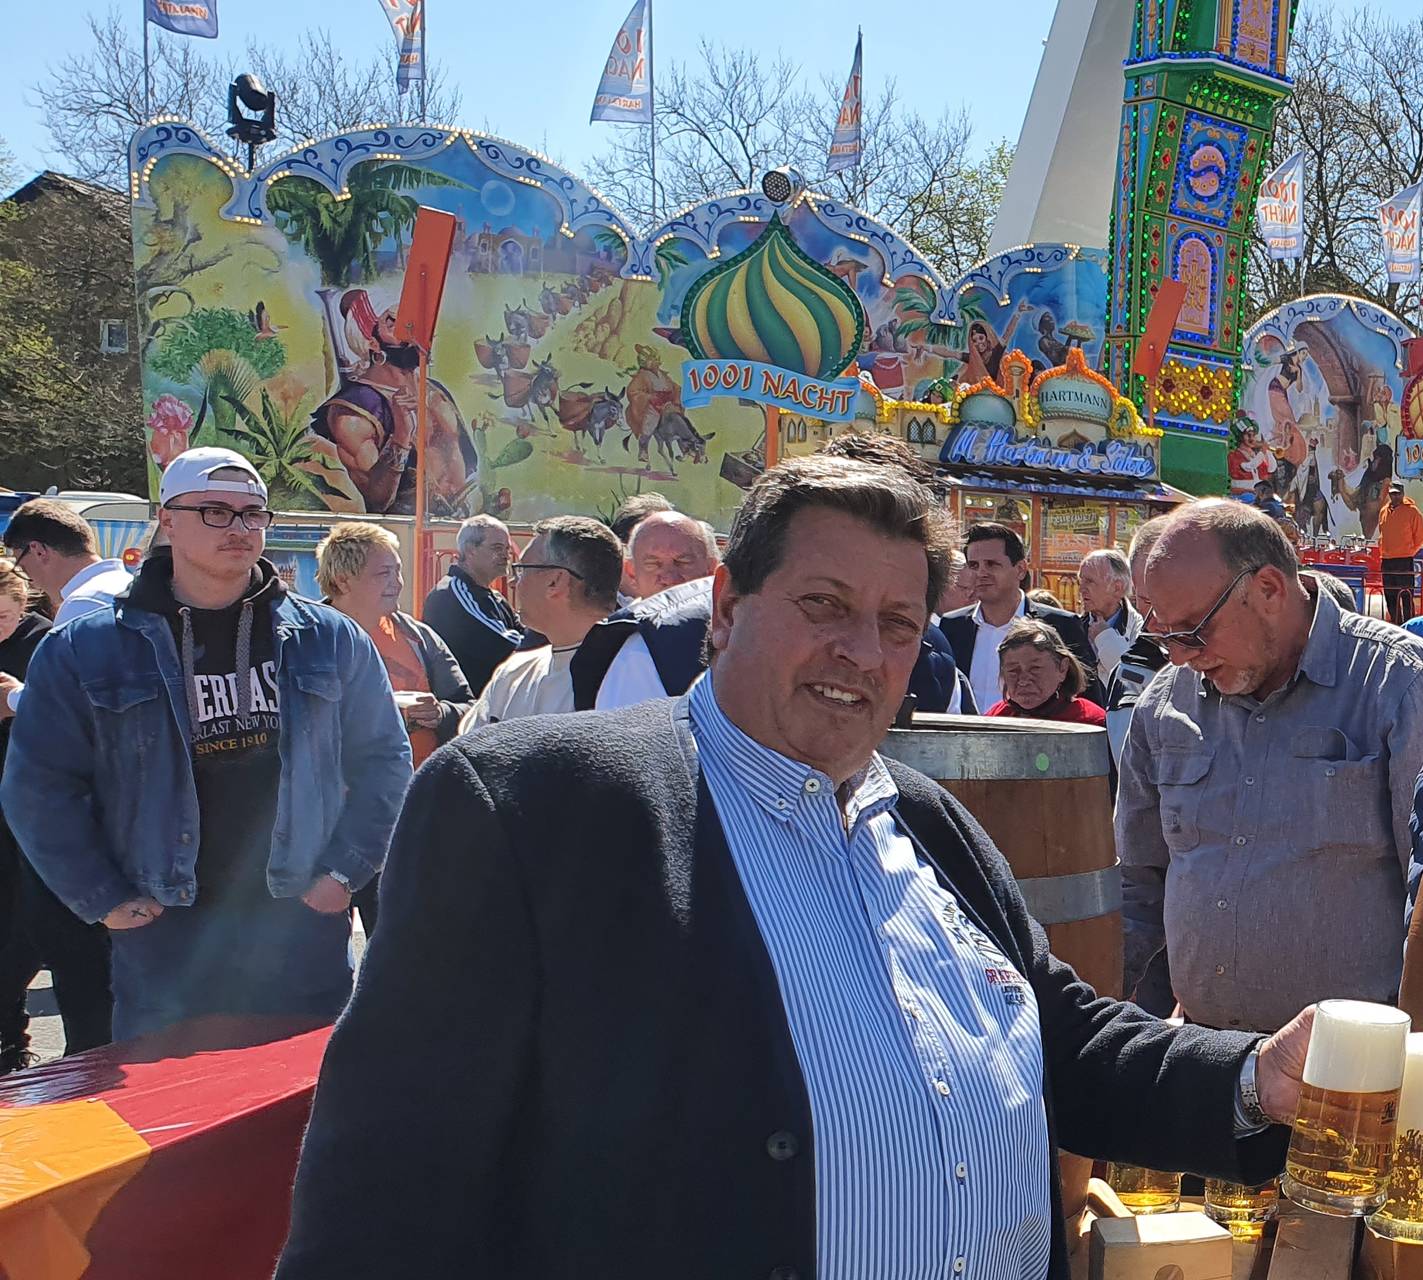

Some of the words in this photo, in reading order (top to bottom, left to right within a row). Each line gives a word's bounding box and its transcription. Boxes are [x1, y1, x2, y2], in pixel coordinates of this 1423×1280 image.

[688, 362, 753, 394] 1001
[760, 369, 855, 416] NACHT
[1040, 390, 1108, 410] HARTMANN
[194, 738, 238, 756] SINCE
[241, 731, 268, 749] 1910
